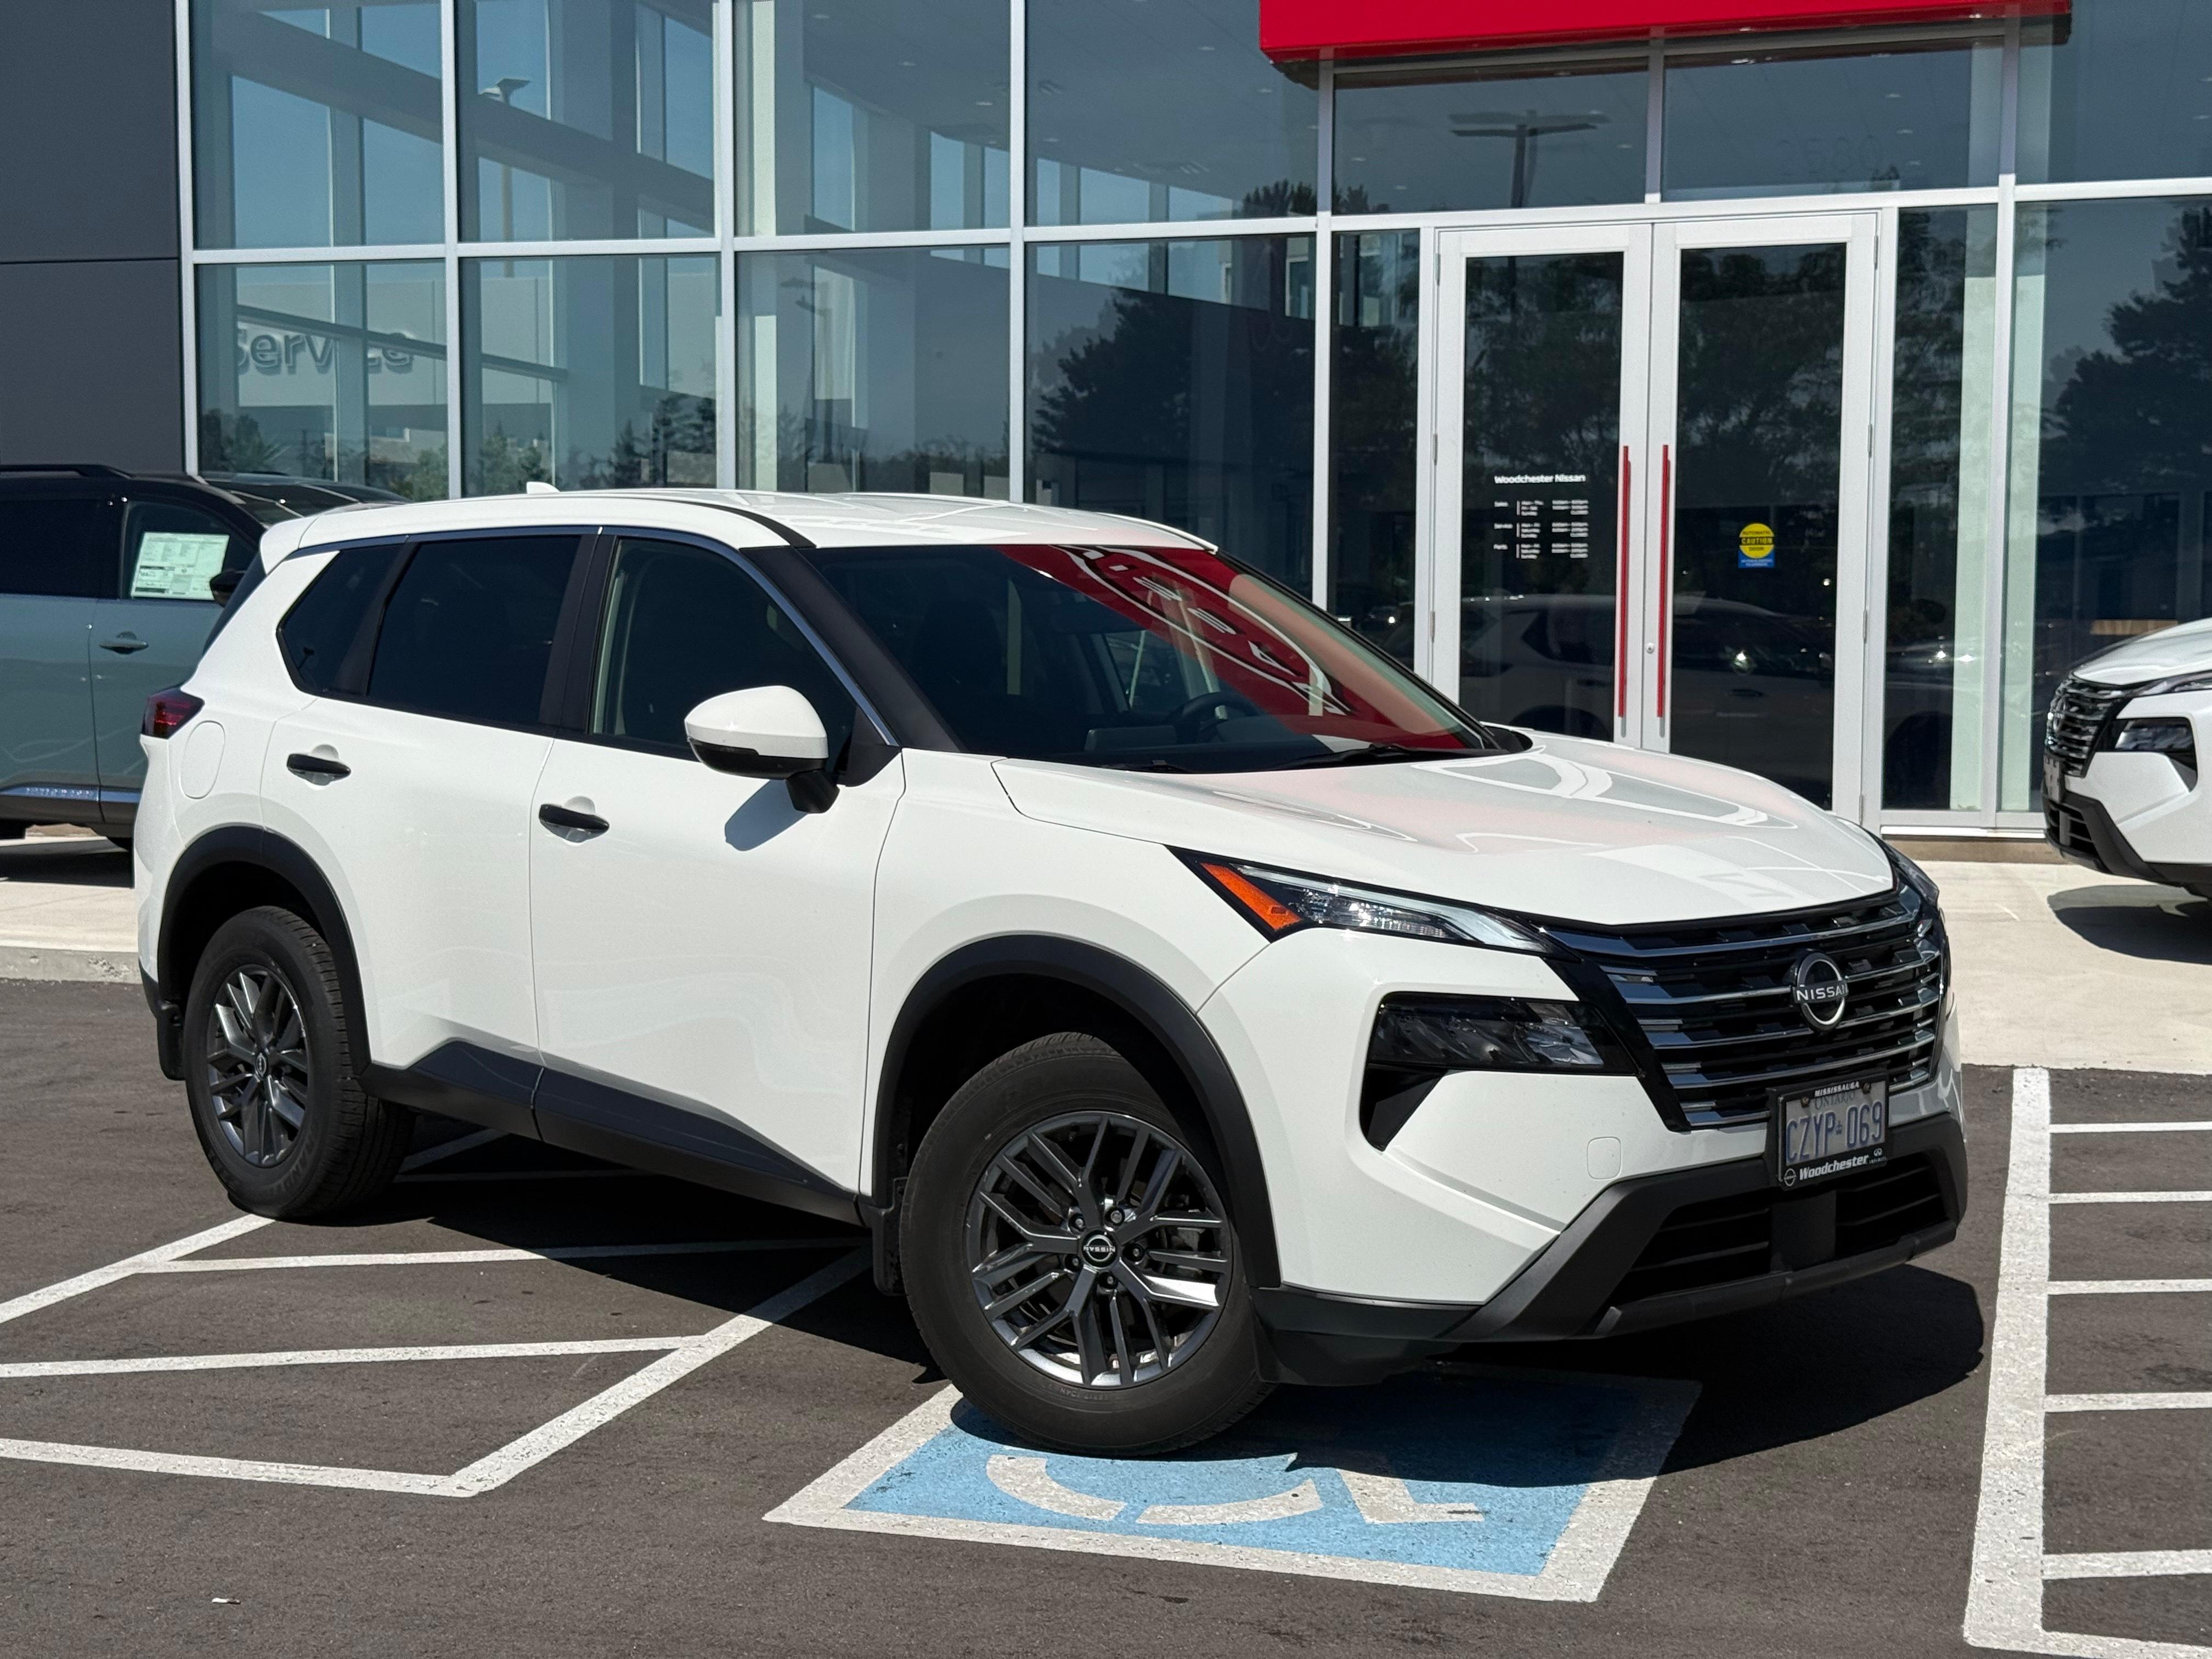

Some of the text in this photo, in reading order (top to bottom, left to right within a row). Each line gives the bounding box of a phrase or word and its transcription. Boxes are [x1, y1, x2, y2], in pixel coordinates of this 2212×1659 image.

[1494, 473, 1586, 484] Woodchester Nissan
[1796, 983, 1848, 1001] NISSAN
[1814, 1081, 1859, 1097] MISSISSAUGA
[1799, 1154, 1869, 1180] Woodchester
